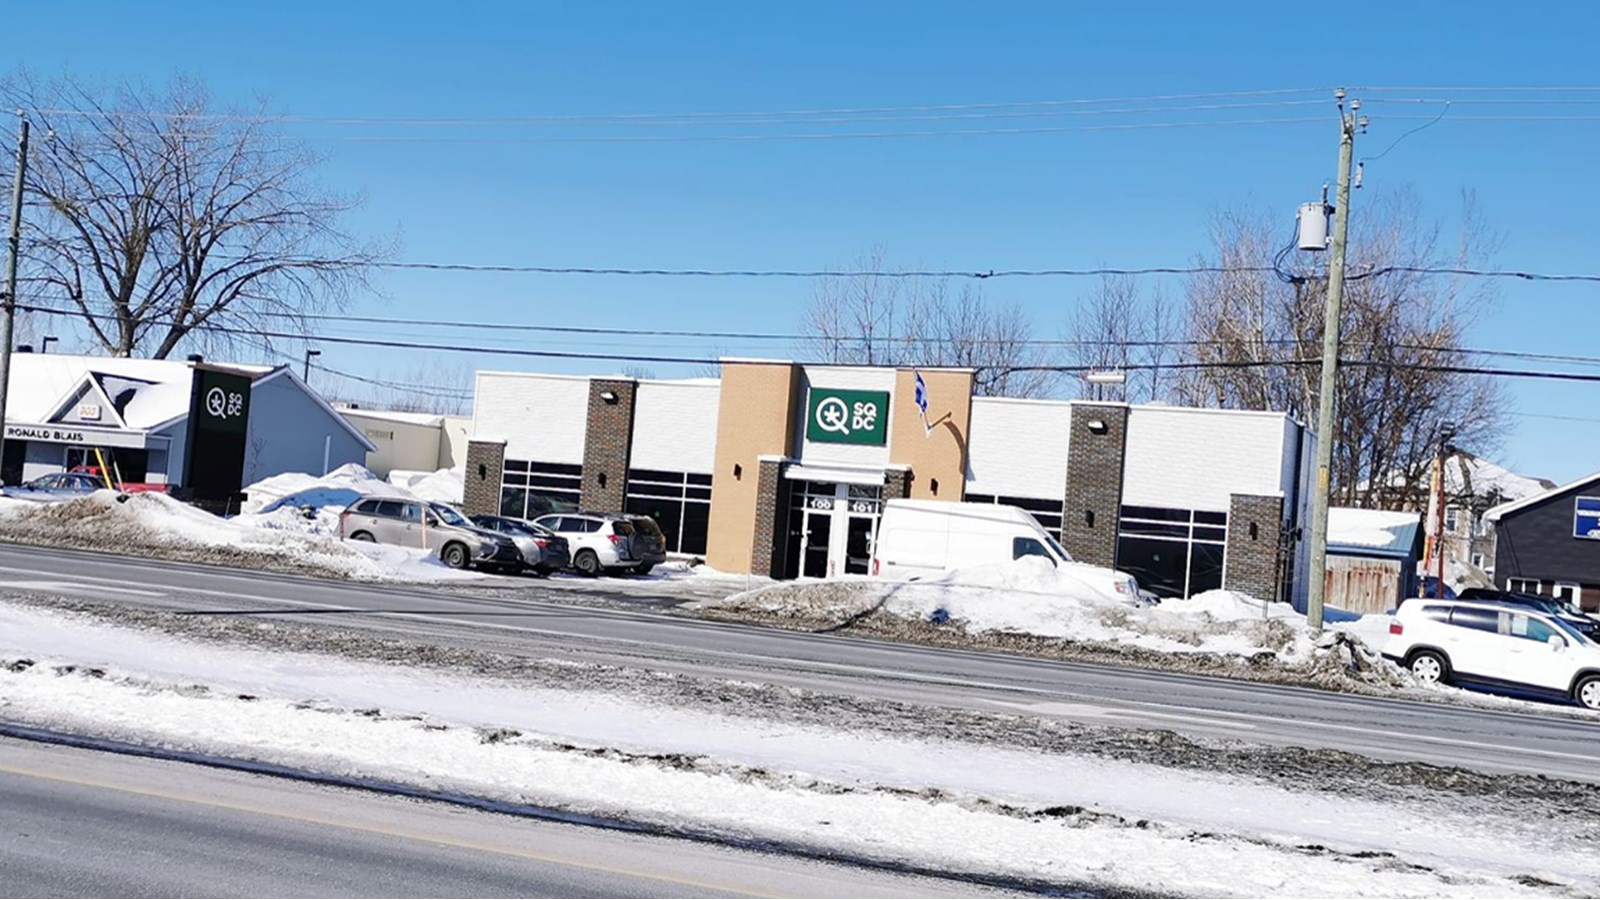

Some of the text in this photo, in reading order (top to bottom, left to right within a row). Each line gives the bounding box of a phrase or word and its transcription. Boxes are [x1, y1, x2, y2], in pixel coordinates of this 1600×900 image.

[228, 392, 243, 405] SQ
[227, 404, 241, 416] DC
[853, 402, 877, 417] SQ
[852, 416, 875, 431] DC
[8, 428, 84, 441] RONALD BLAIS
[852, 501, 872, 512] 101
